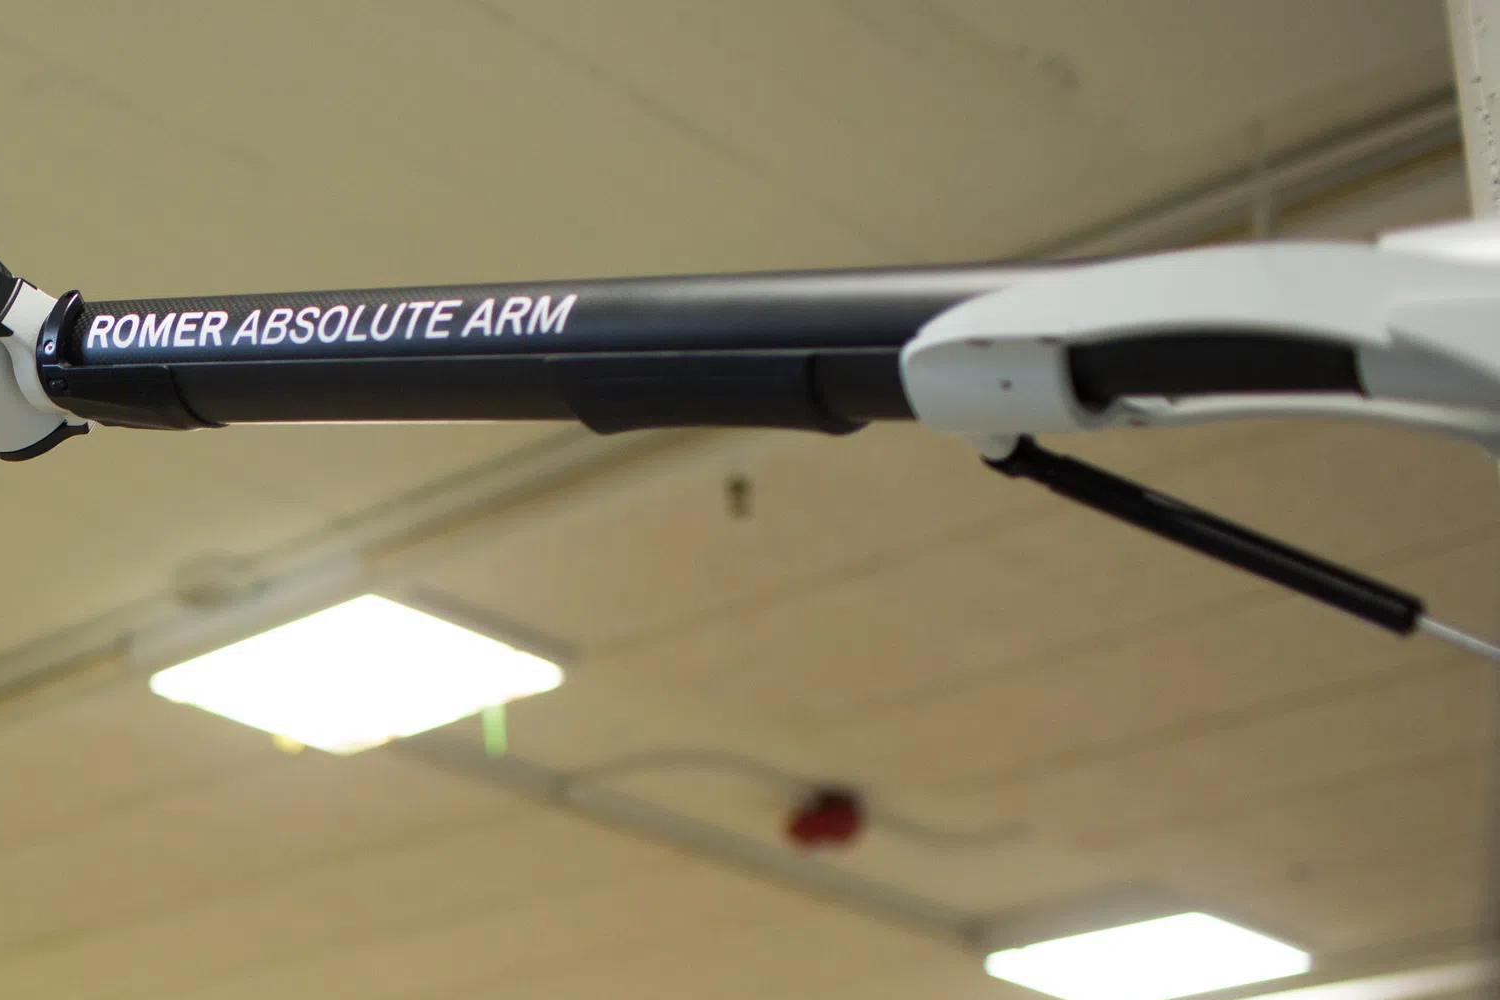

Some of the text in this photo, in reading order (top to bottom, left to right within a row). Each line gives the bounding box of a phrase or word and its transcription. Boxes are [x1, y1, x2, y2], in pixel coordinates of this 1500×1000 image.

[87, 294, 578, 348] ROMER ABSOLUTE ARM
